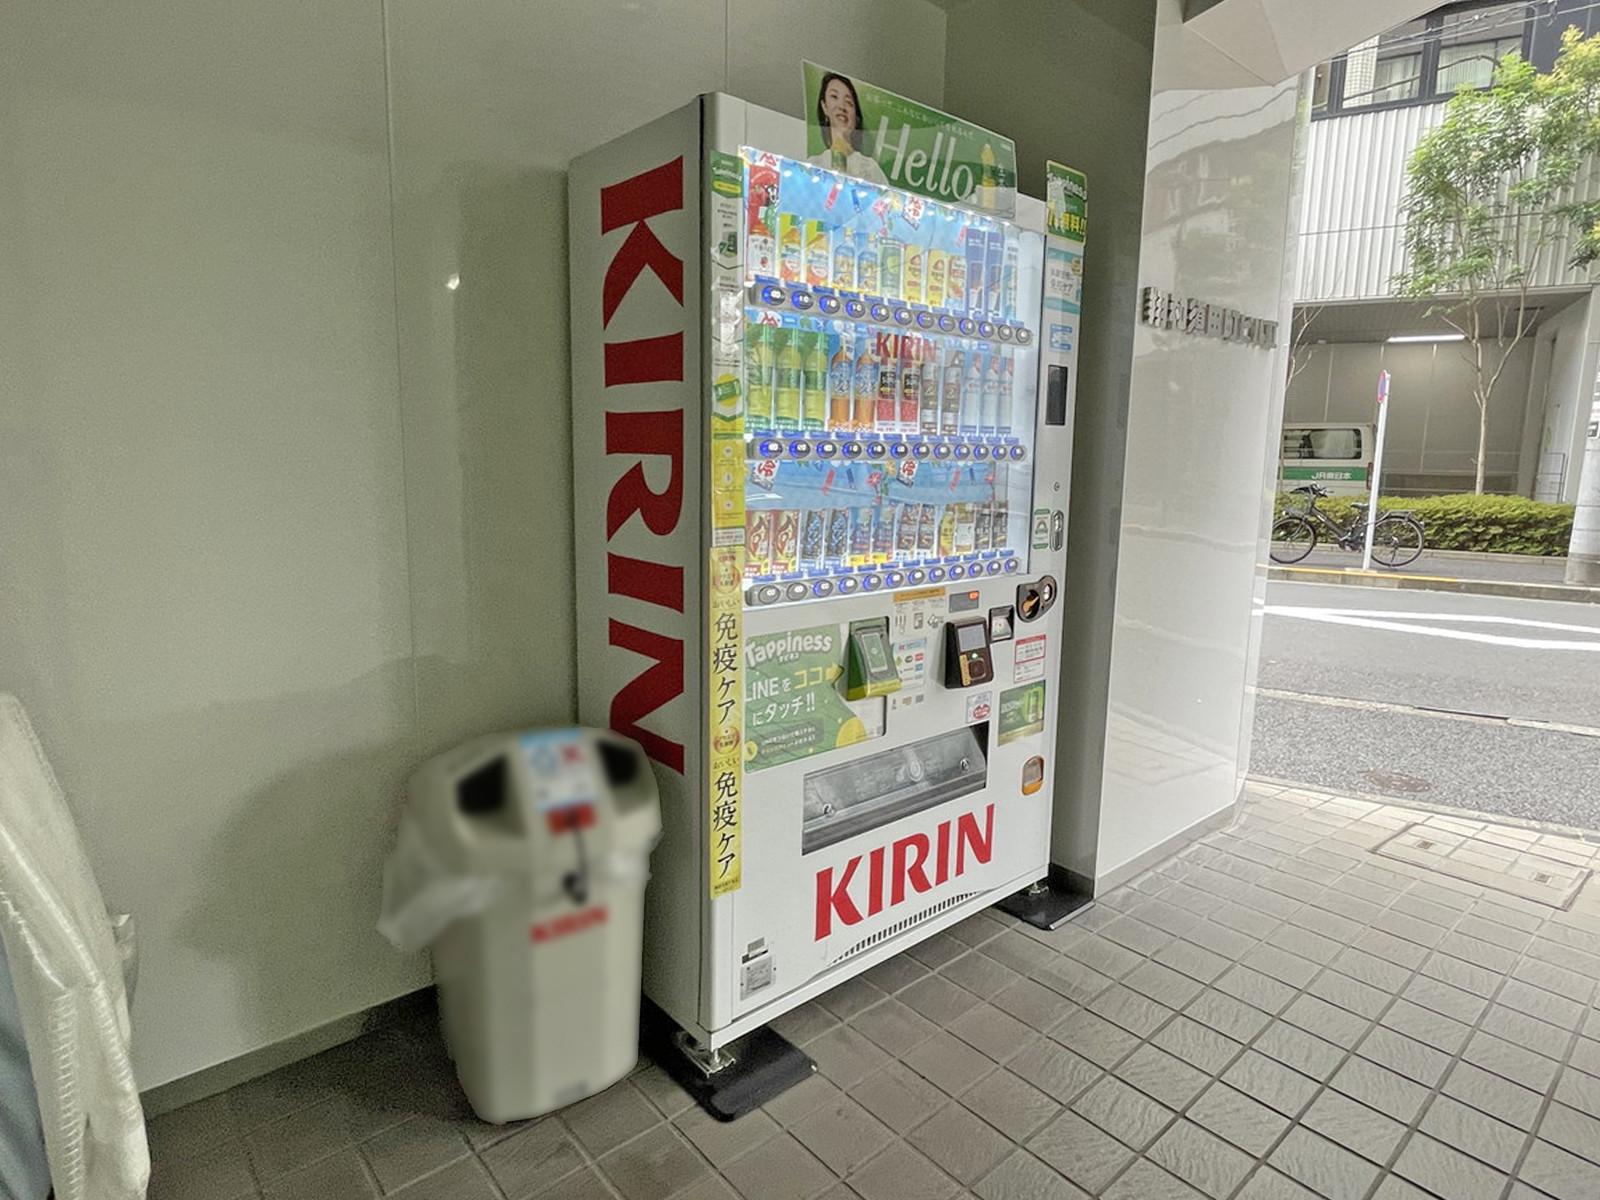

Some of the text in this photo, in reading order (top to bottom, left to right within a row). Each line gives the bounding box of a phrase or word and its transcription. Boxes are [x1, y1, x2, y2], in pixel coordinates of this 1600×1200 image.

[601, 154, 685, 775] KIRIN
[1311, 471, 1352, 480] JR東日本
[713, 612, 739, 726] 免疫ケア
[745, 631, 832, 668] Tappiness
[752, 691, 816, 727] にタッチ!!
[713, 770, 739, 879] 免疫ケア
[814, 802, 995, 942] KIRIN
